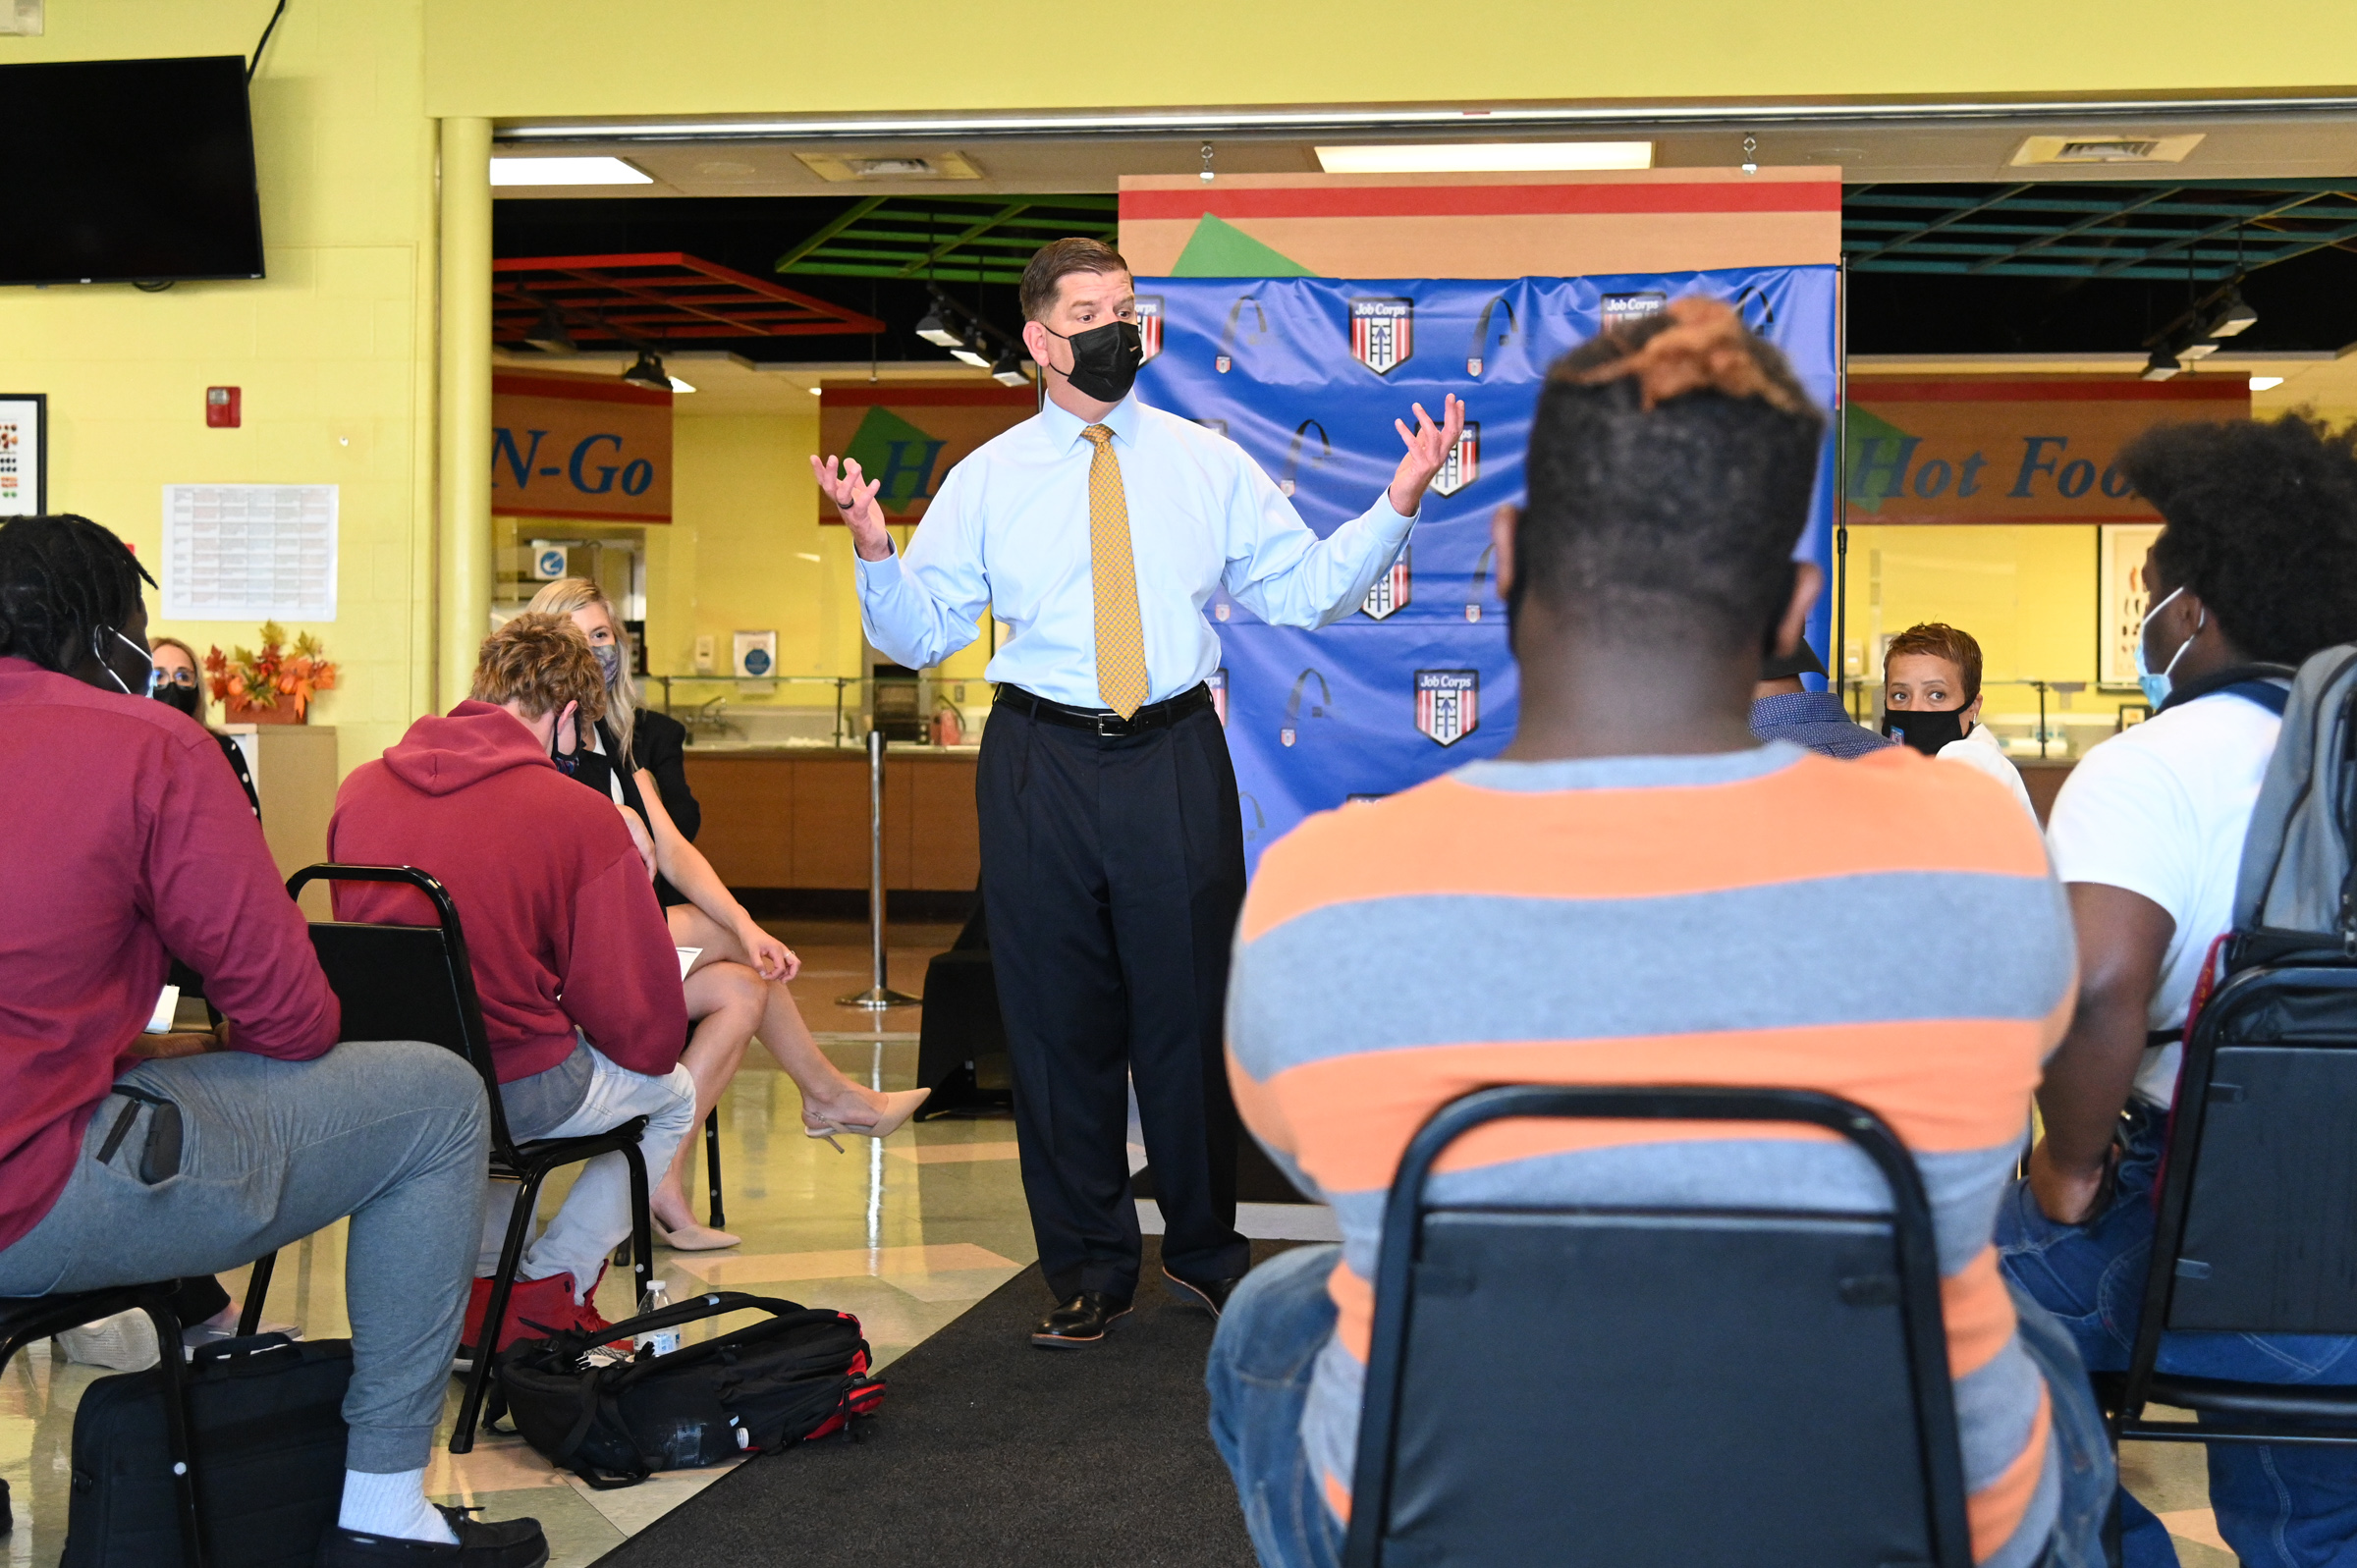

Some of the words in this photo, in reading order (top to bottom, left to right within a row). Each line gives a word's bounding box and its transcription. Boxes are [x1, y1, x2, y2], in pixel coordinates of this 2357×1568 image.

[1134, 303, 1157, 315] orps
[1355, 303, 1374, 315] Job
[1375, 303, 1406, 317] Corps
[1607, 298, 1626, 311] Job
[1627, 298, 1659, 311] Corps
[1850, 436, 1990, 500] Hot
[1420, 676, 1439, 687] Job
[1440, 676, 1471, 689] Corps
